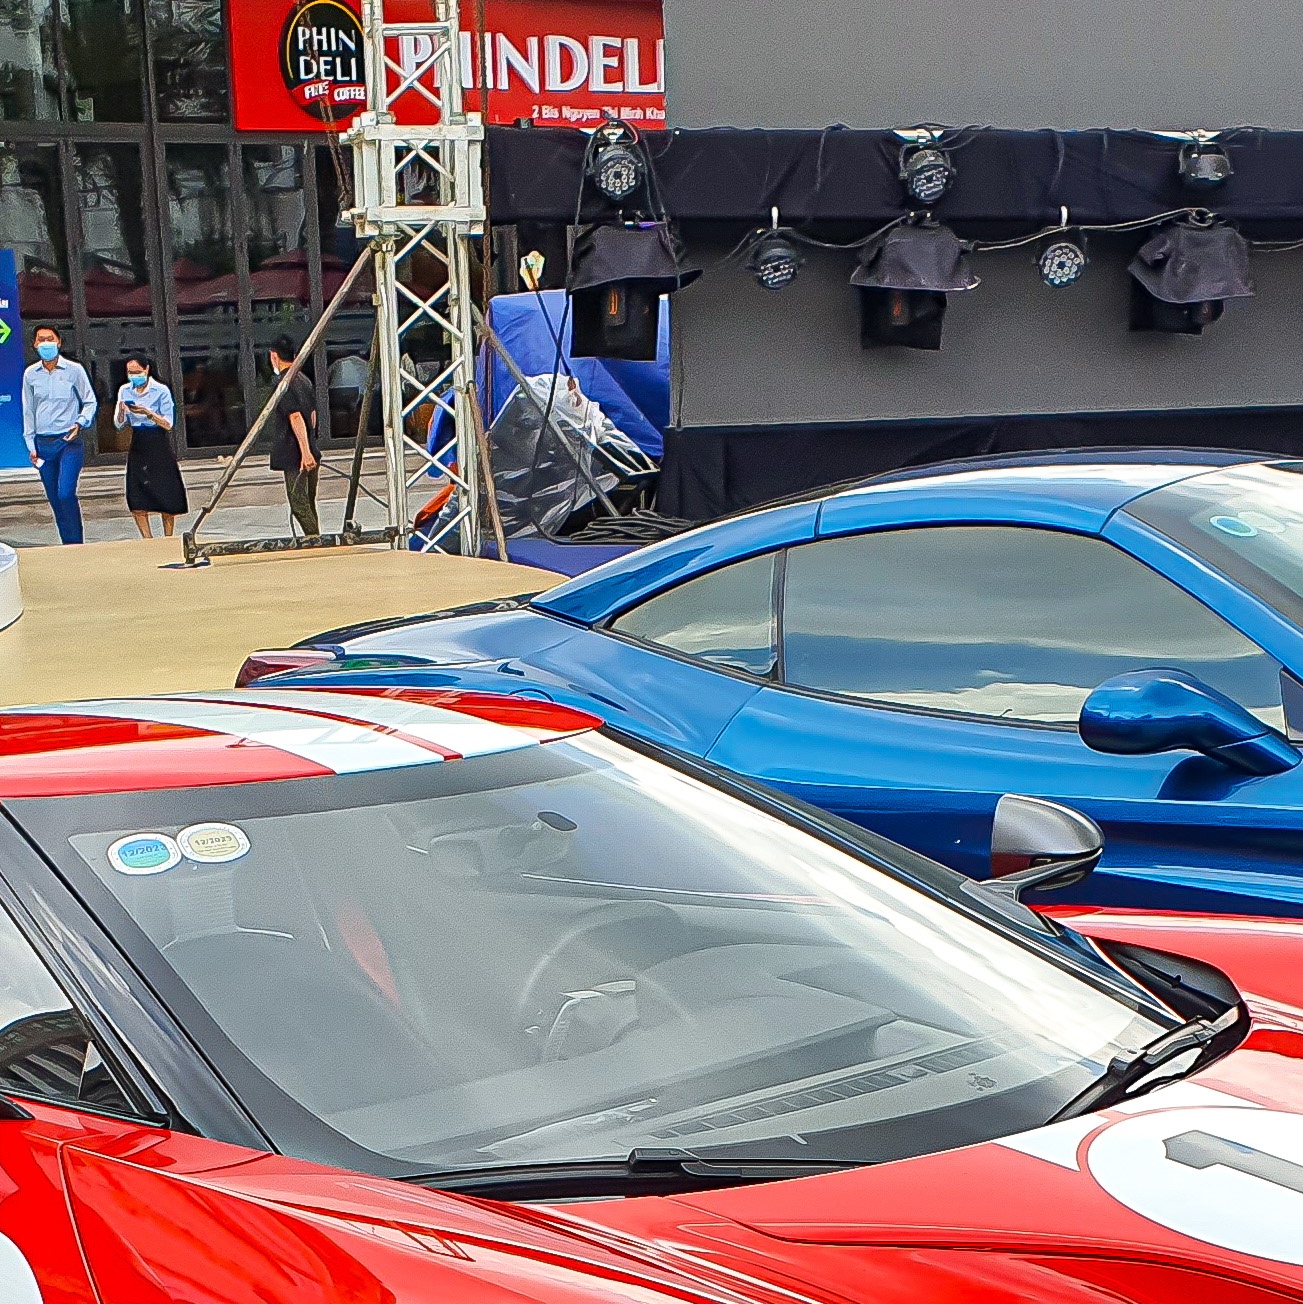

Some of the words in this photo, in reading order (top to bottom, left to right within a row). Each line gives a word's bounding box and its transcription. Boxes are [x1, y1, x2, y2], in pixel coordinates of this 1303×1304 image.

[297, 26, 356, 51] PHIN
[299, 55, 357, 81] DELI
[532, 104, 540, 119] 2
